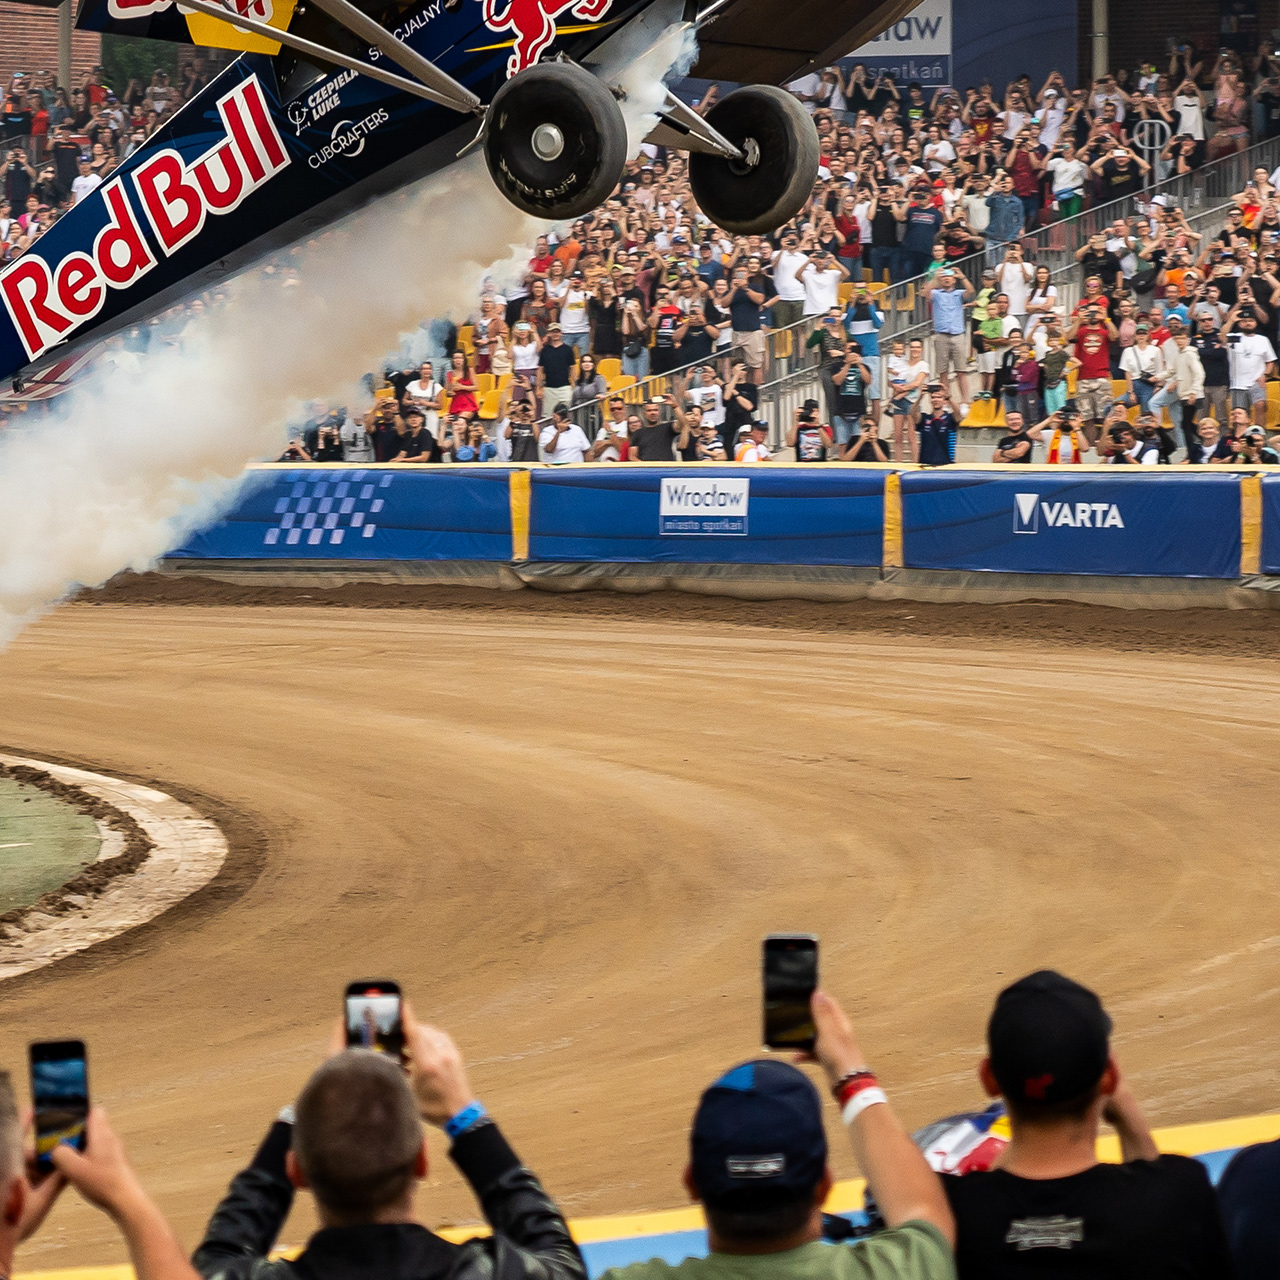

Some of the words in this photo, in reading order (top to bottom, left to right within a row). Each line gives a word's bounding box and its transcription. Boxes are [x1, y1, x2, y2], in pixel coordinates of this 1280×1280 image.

[368, 0, 441, 61] SCJALNY
[307, 69, 360, 108] CZEPIELA
[312, 93, 341, 121] LUKE
[308, 108, 389, 169] CUBCRAFTERS
[131, 73, 292, 258] Bull
[1042, 503, 1125, 529] VARTA
